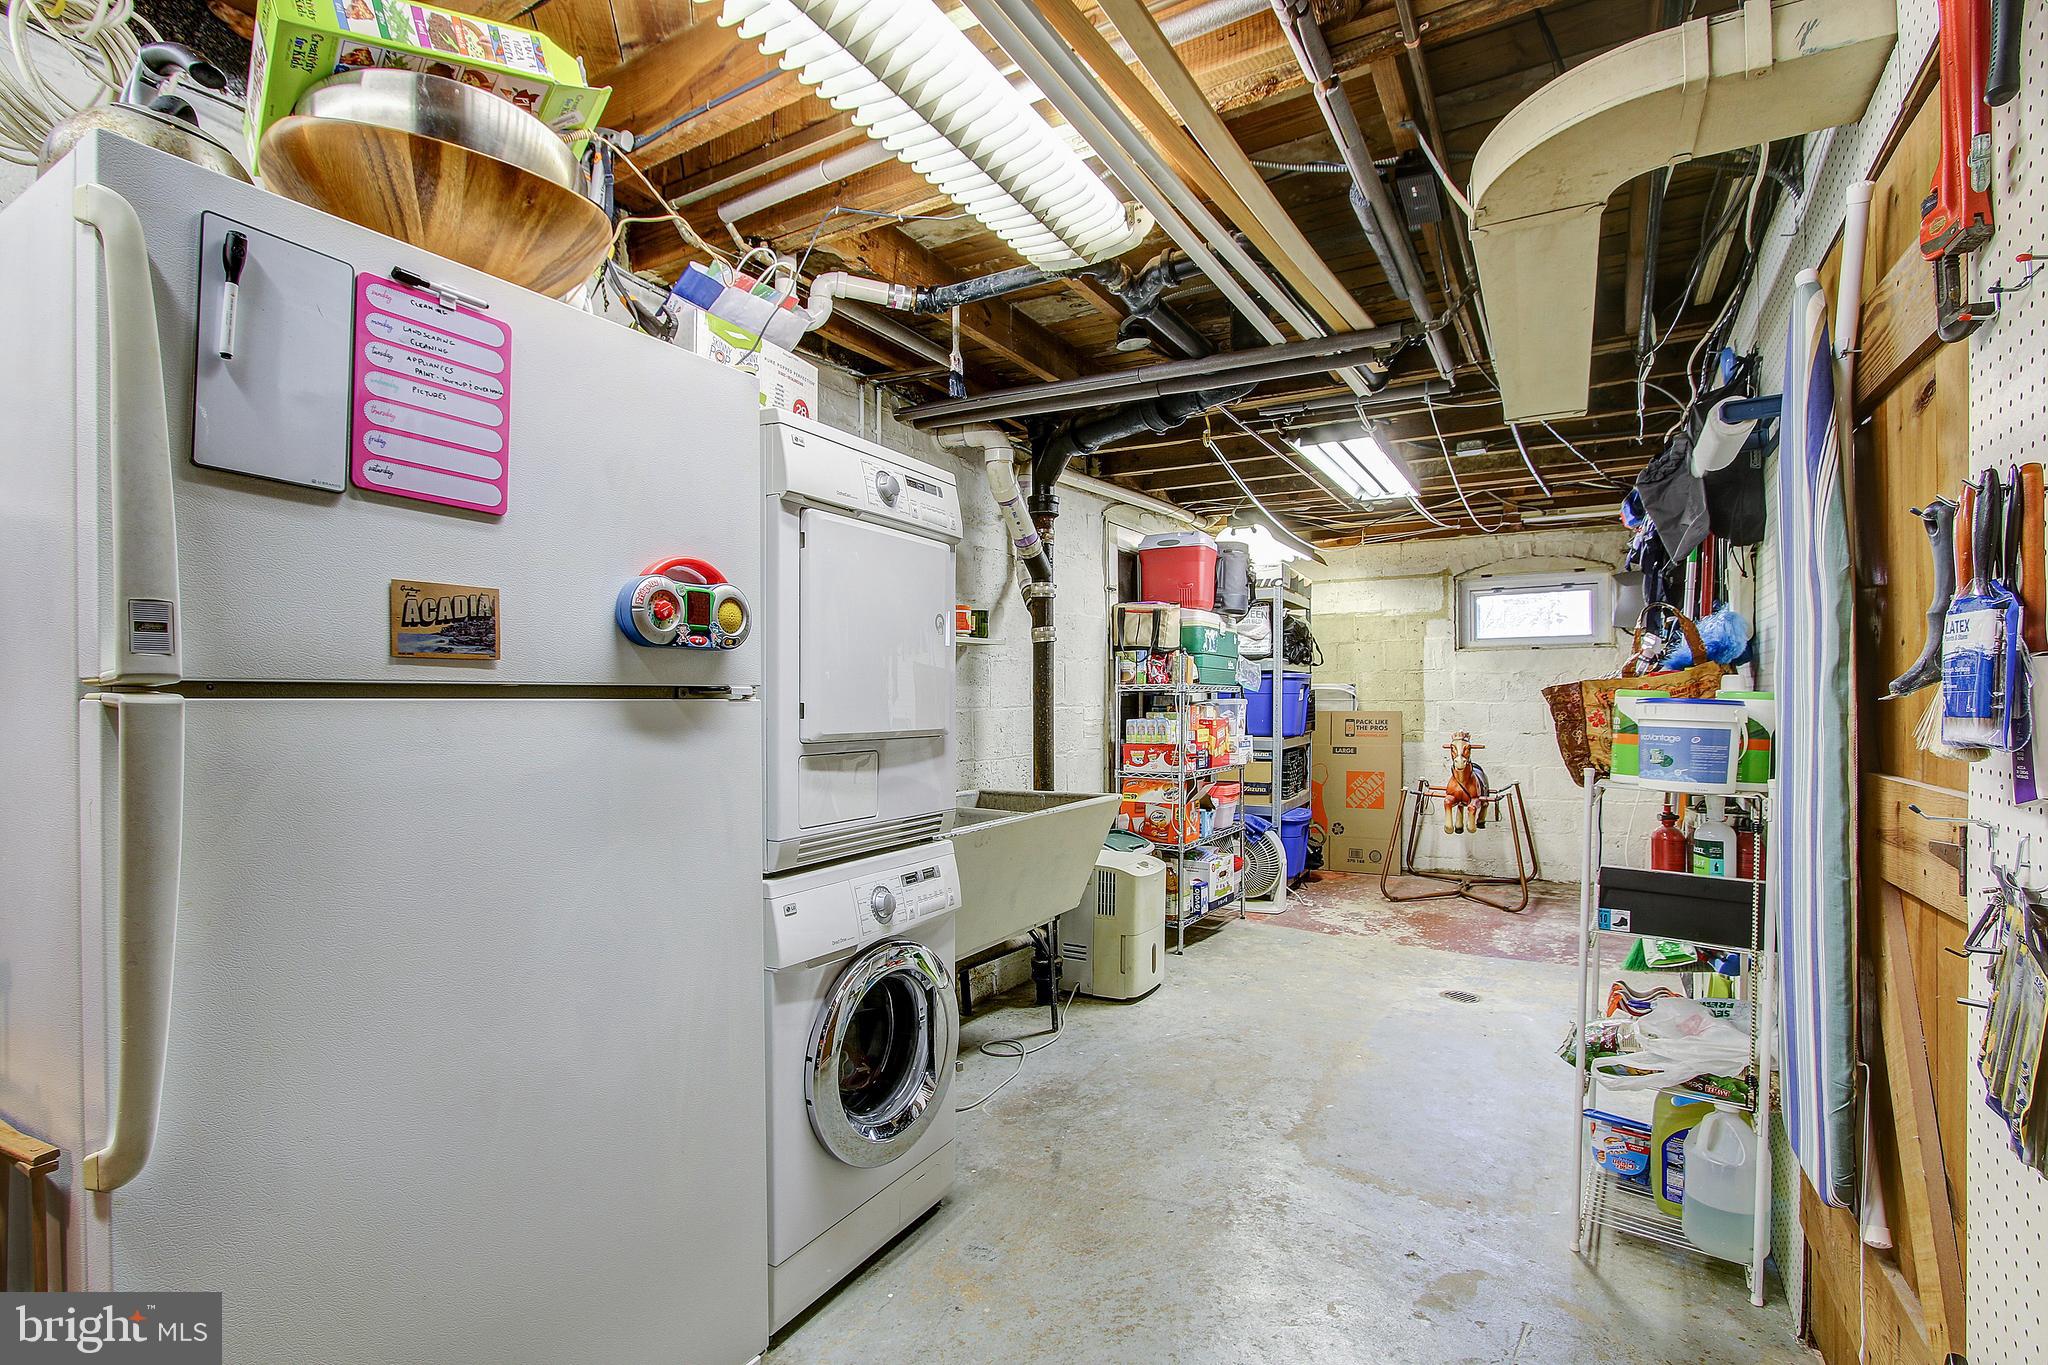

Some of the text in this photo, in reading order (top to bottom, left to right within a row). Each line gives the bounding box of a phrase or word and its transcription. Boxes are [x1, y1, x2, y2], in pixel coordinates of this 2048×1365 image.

[290, 36, 307, 69] for Kids
[303, 33, 324, 74] Creativity
[402, 325, 456, 346] LANDSCAPING
[410, 338, 449, 354] CLEANING
[406, 356, 454, 374] APPLIANCES
[709, 344, 731, 366] POP
[415, 367, 435, 379] PAINT
[412, 386, 447, 401] PICTURES
[796, 404, 806, 418] 28
[403, 592, 492, 626] ACADIA
[1944, 619, 1970, 634] LATEX
[1347, 772, 1384, 807] HOME
[1361, 786, 1384, 808] DEPOT
[1193, 888, 1201, 912] Tovolo
[1600, 914, 1607, 923] 10
